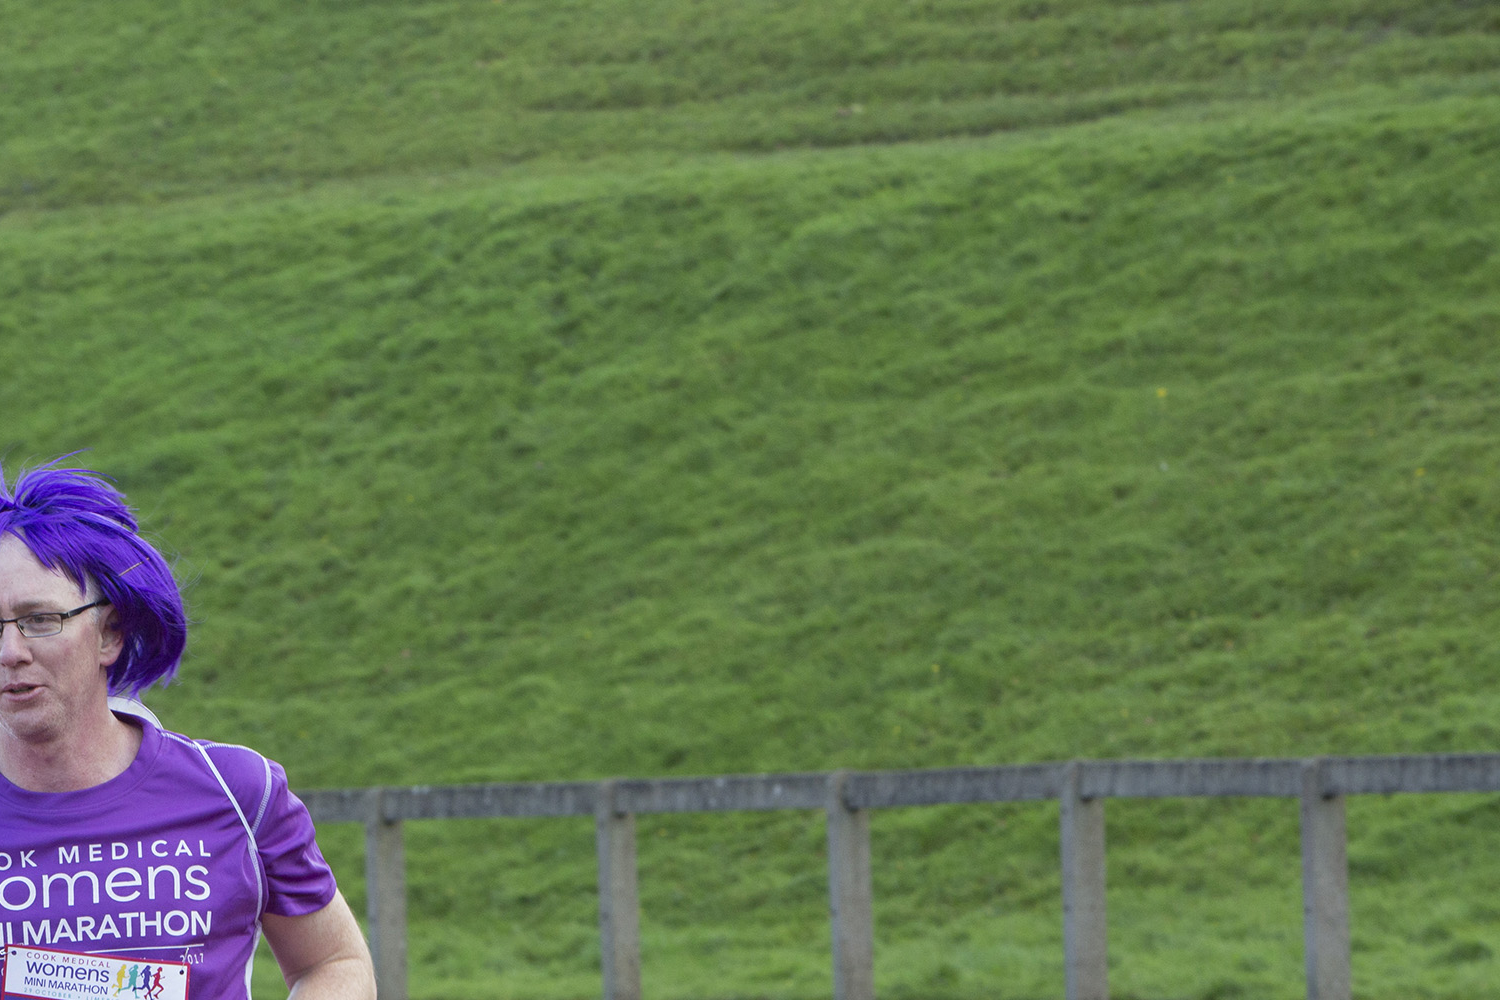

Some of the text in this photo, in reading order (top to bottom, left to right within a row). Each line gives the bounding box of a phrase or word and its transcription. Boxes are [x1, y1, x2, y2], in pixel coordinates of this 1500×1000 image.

[58, 839, 212, 864] MEDICAL
[22, 910, 212, 946] MARATHON
[26, 952, 111, 968] COOK MEDICAL
[26, 960, 110, 983] womens
[24, 976, 108, 995] MINI MARATHON
[35, 988, 72, 999] OCTOBER
